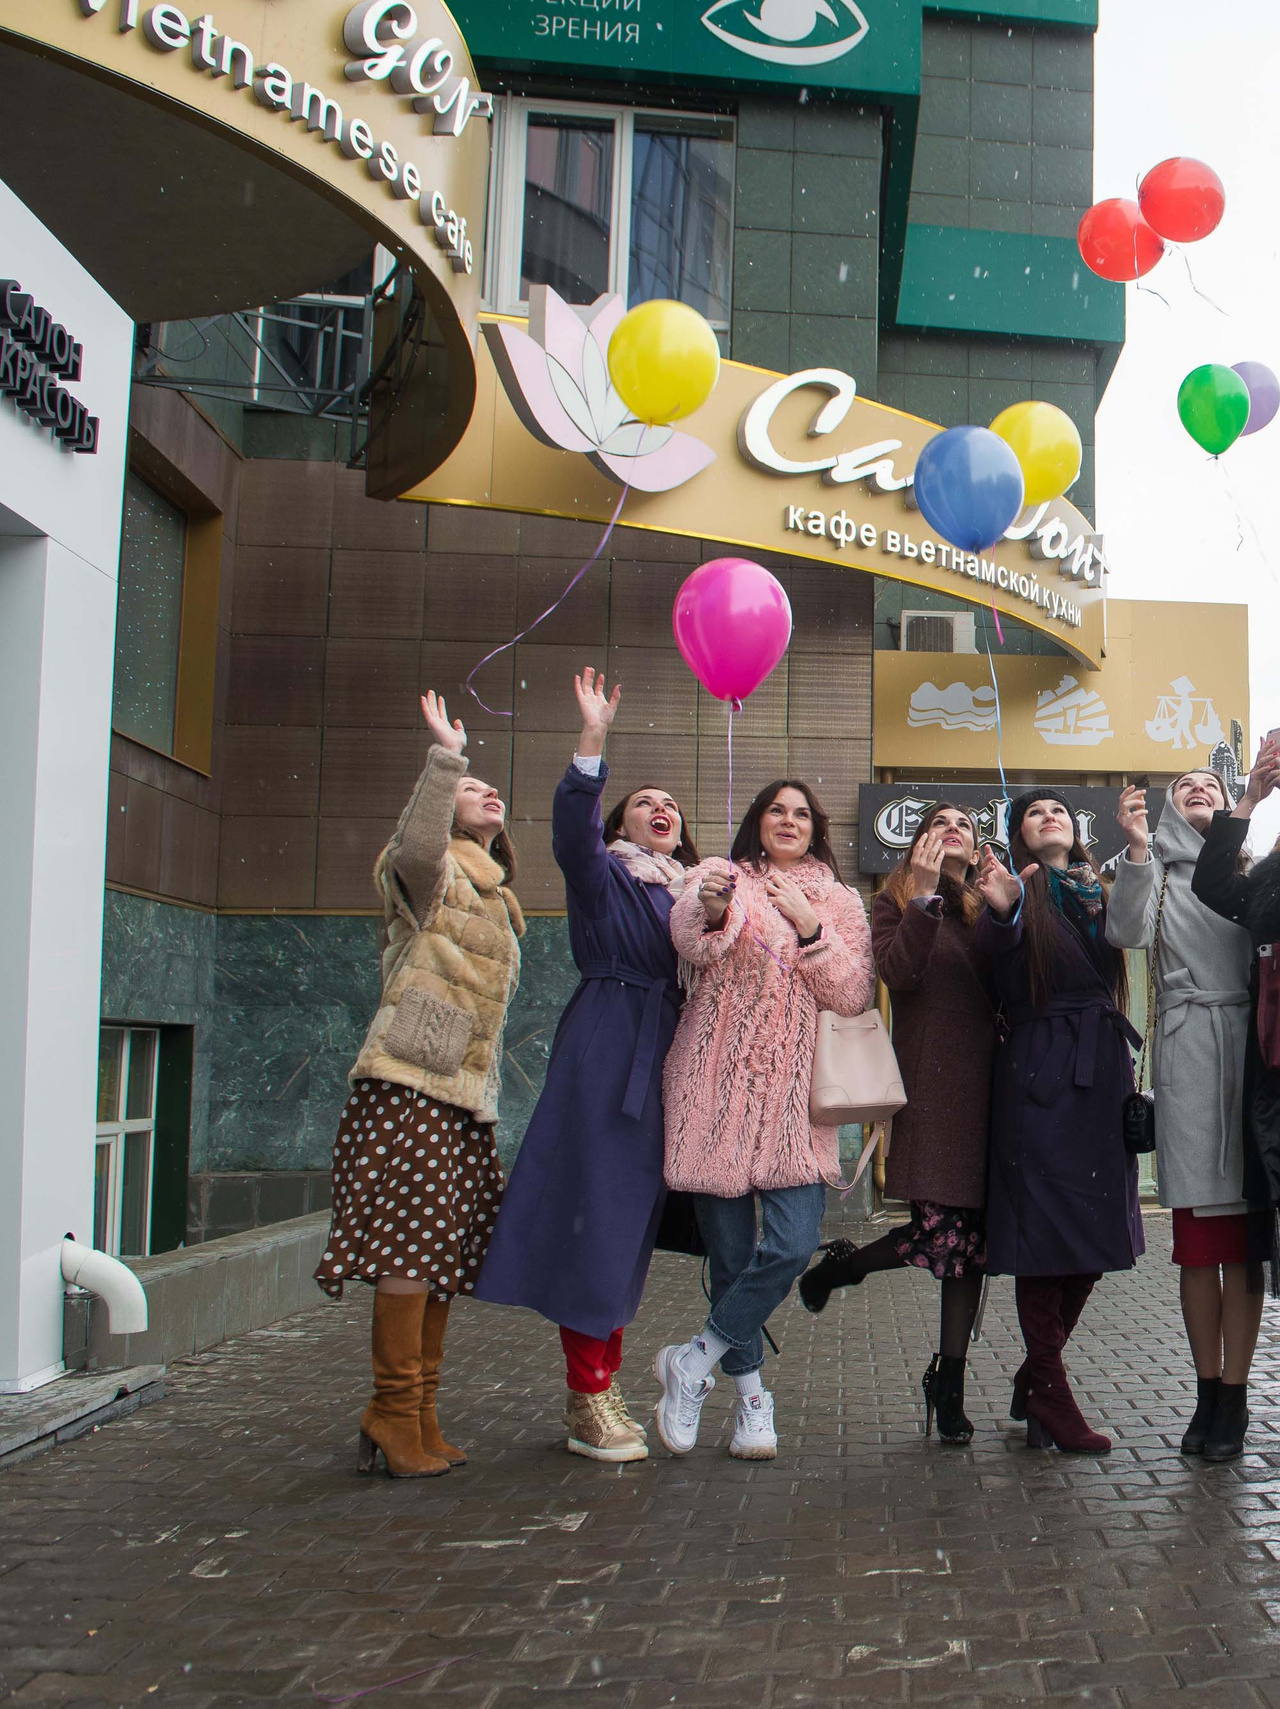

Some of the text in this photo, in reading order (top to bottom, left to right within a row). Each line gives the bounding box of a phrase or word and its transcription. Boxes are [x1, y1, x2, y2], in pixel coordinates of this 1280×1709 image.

[534, 14, 641, 44] ЗРЕНИЯ
[87, 0, 473, 275] etnamese cafe
[3, 279, 84, 383] САЛОН
[0, 336, 100, 455] КРАСОТЫ
[787, 504, 1082, 628] кафе вьетнамской кухни
